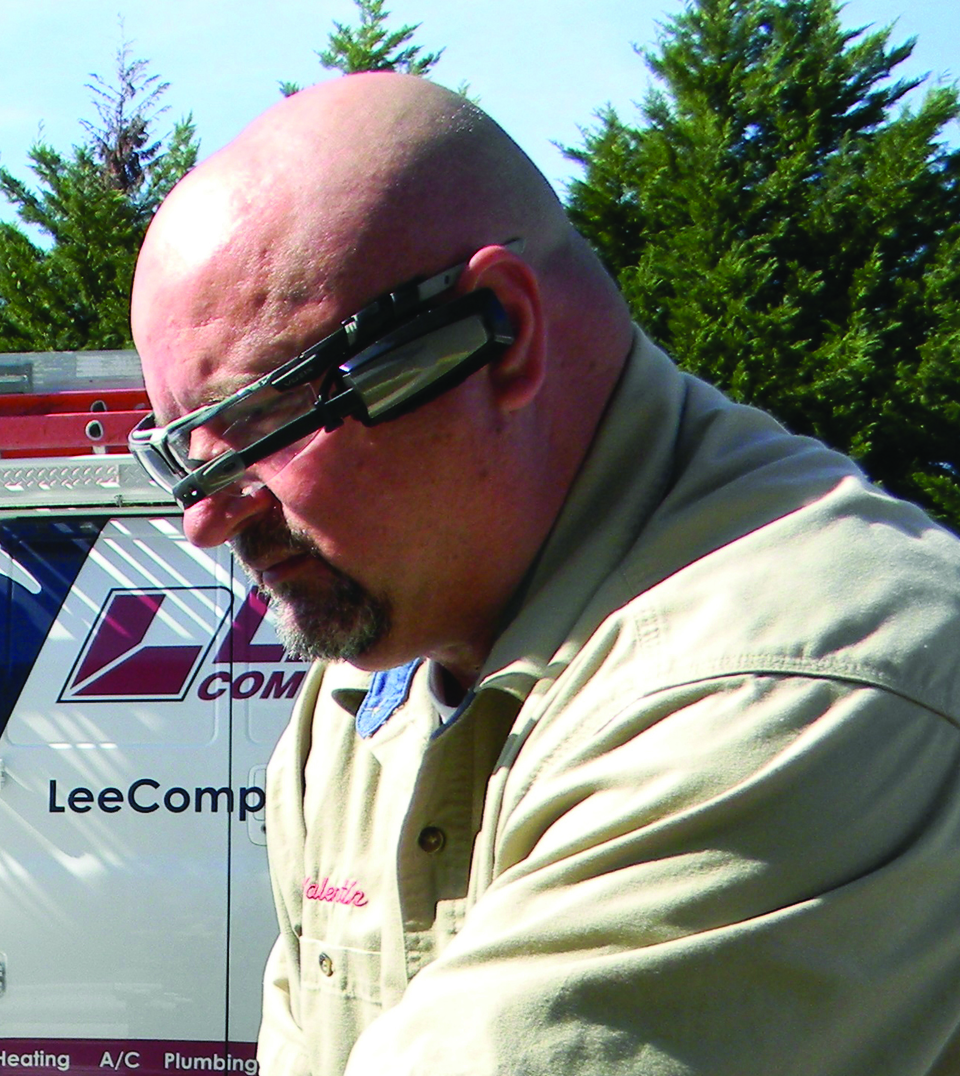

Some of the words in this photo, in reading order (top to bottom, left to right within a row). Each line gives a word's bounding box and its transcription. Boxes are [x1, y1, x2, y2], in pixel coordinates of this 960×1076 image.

[213, 585, 303, 663] L
[302, 877, 369, 907] alentin
[99, 1051, 140, 1070] A/C
[164, 1053, 258, 1076] Plumbing
